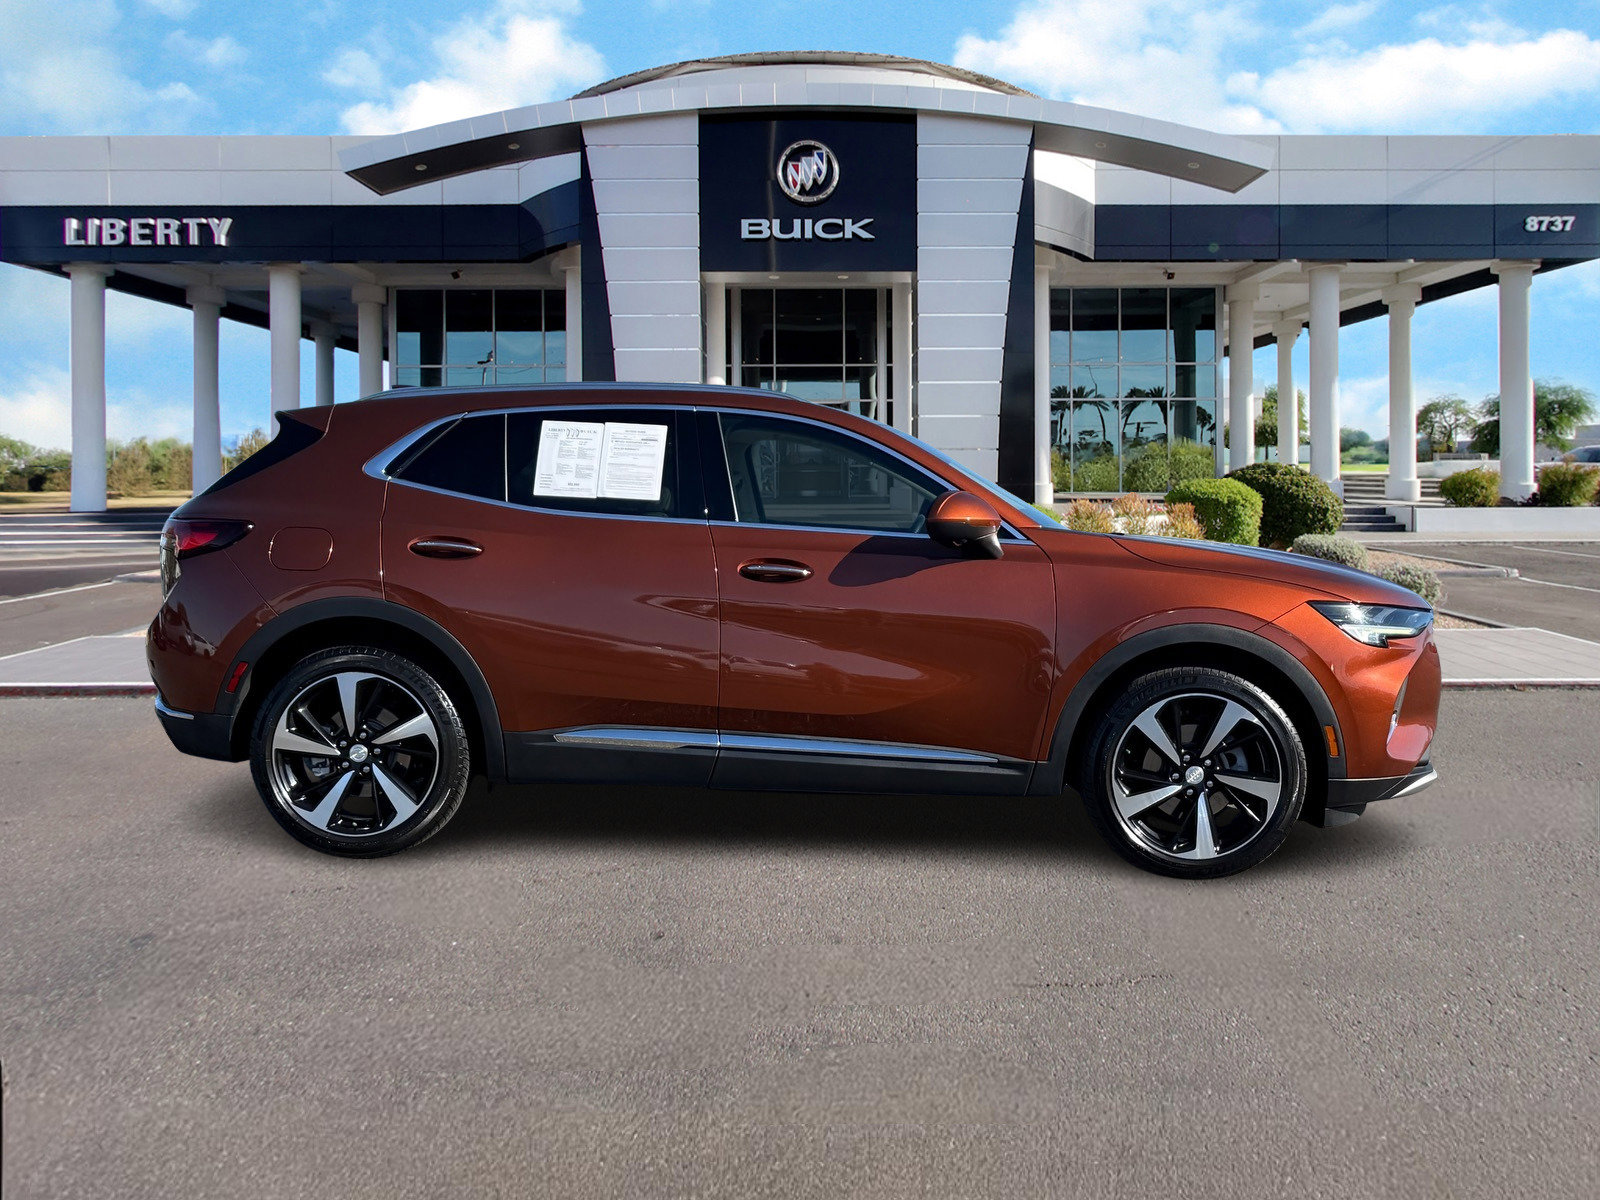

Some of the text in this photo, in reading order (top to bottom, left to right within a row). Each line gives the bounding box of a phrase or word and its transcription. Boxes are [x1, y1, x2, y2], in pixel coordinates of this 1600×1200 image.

[64, 217, 233, 246] LIBERTY
[741, 218, 876, 239] BUICK
[1525, 215, 1576, 232] 8737
